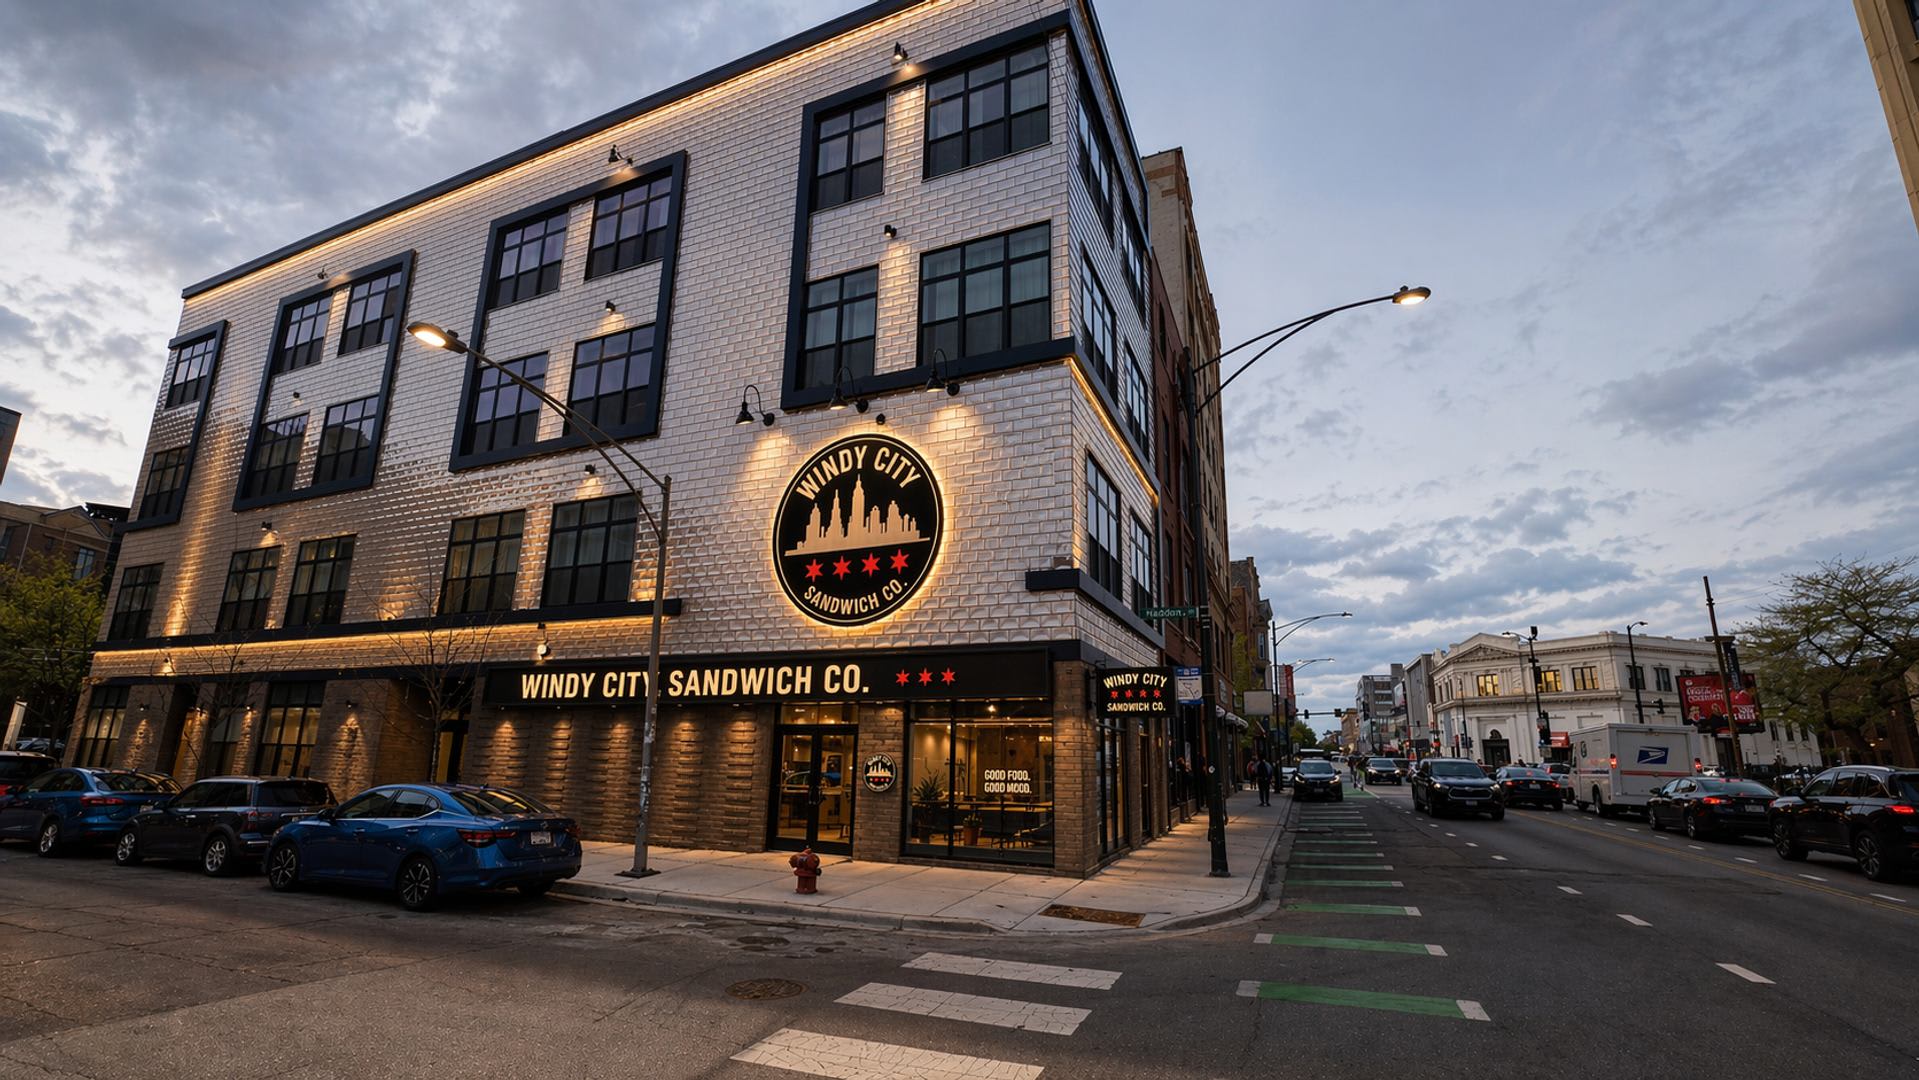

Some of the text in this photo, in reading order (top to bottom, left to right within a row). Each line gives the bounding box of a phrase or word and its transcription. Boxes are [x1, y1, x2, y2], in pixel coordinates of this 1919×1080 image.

[796, 445, 921, 500] WINDY CITY
[804, 579, 908, 615] SANDWICH CO.
[521, 673, 595, 699] WINDY
[668, 666, 812, 697] SANDWICH
[824, 664, 869, 694] CO.
[1103, 673, 1168, 688] WINDY CITY
[1106, 701, 1166, 712] SANDWICH CO.
[984, 769, 1031, 781] GOOD FOOD.
[984, 782, 1032, 794] GOOD MOOD.
